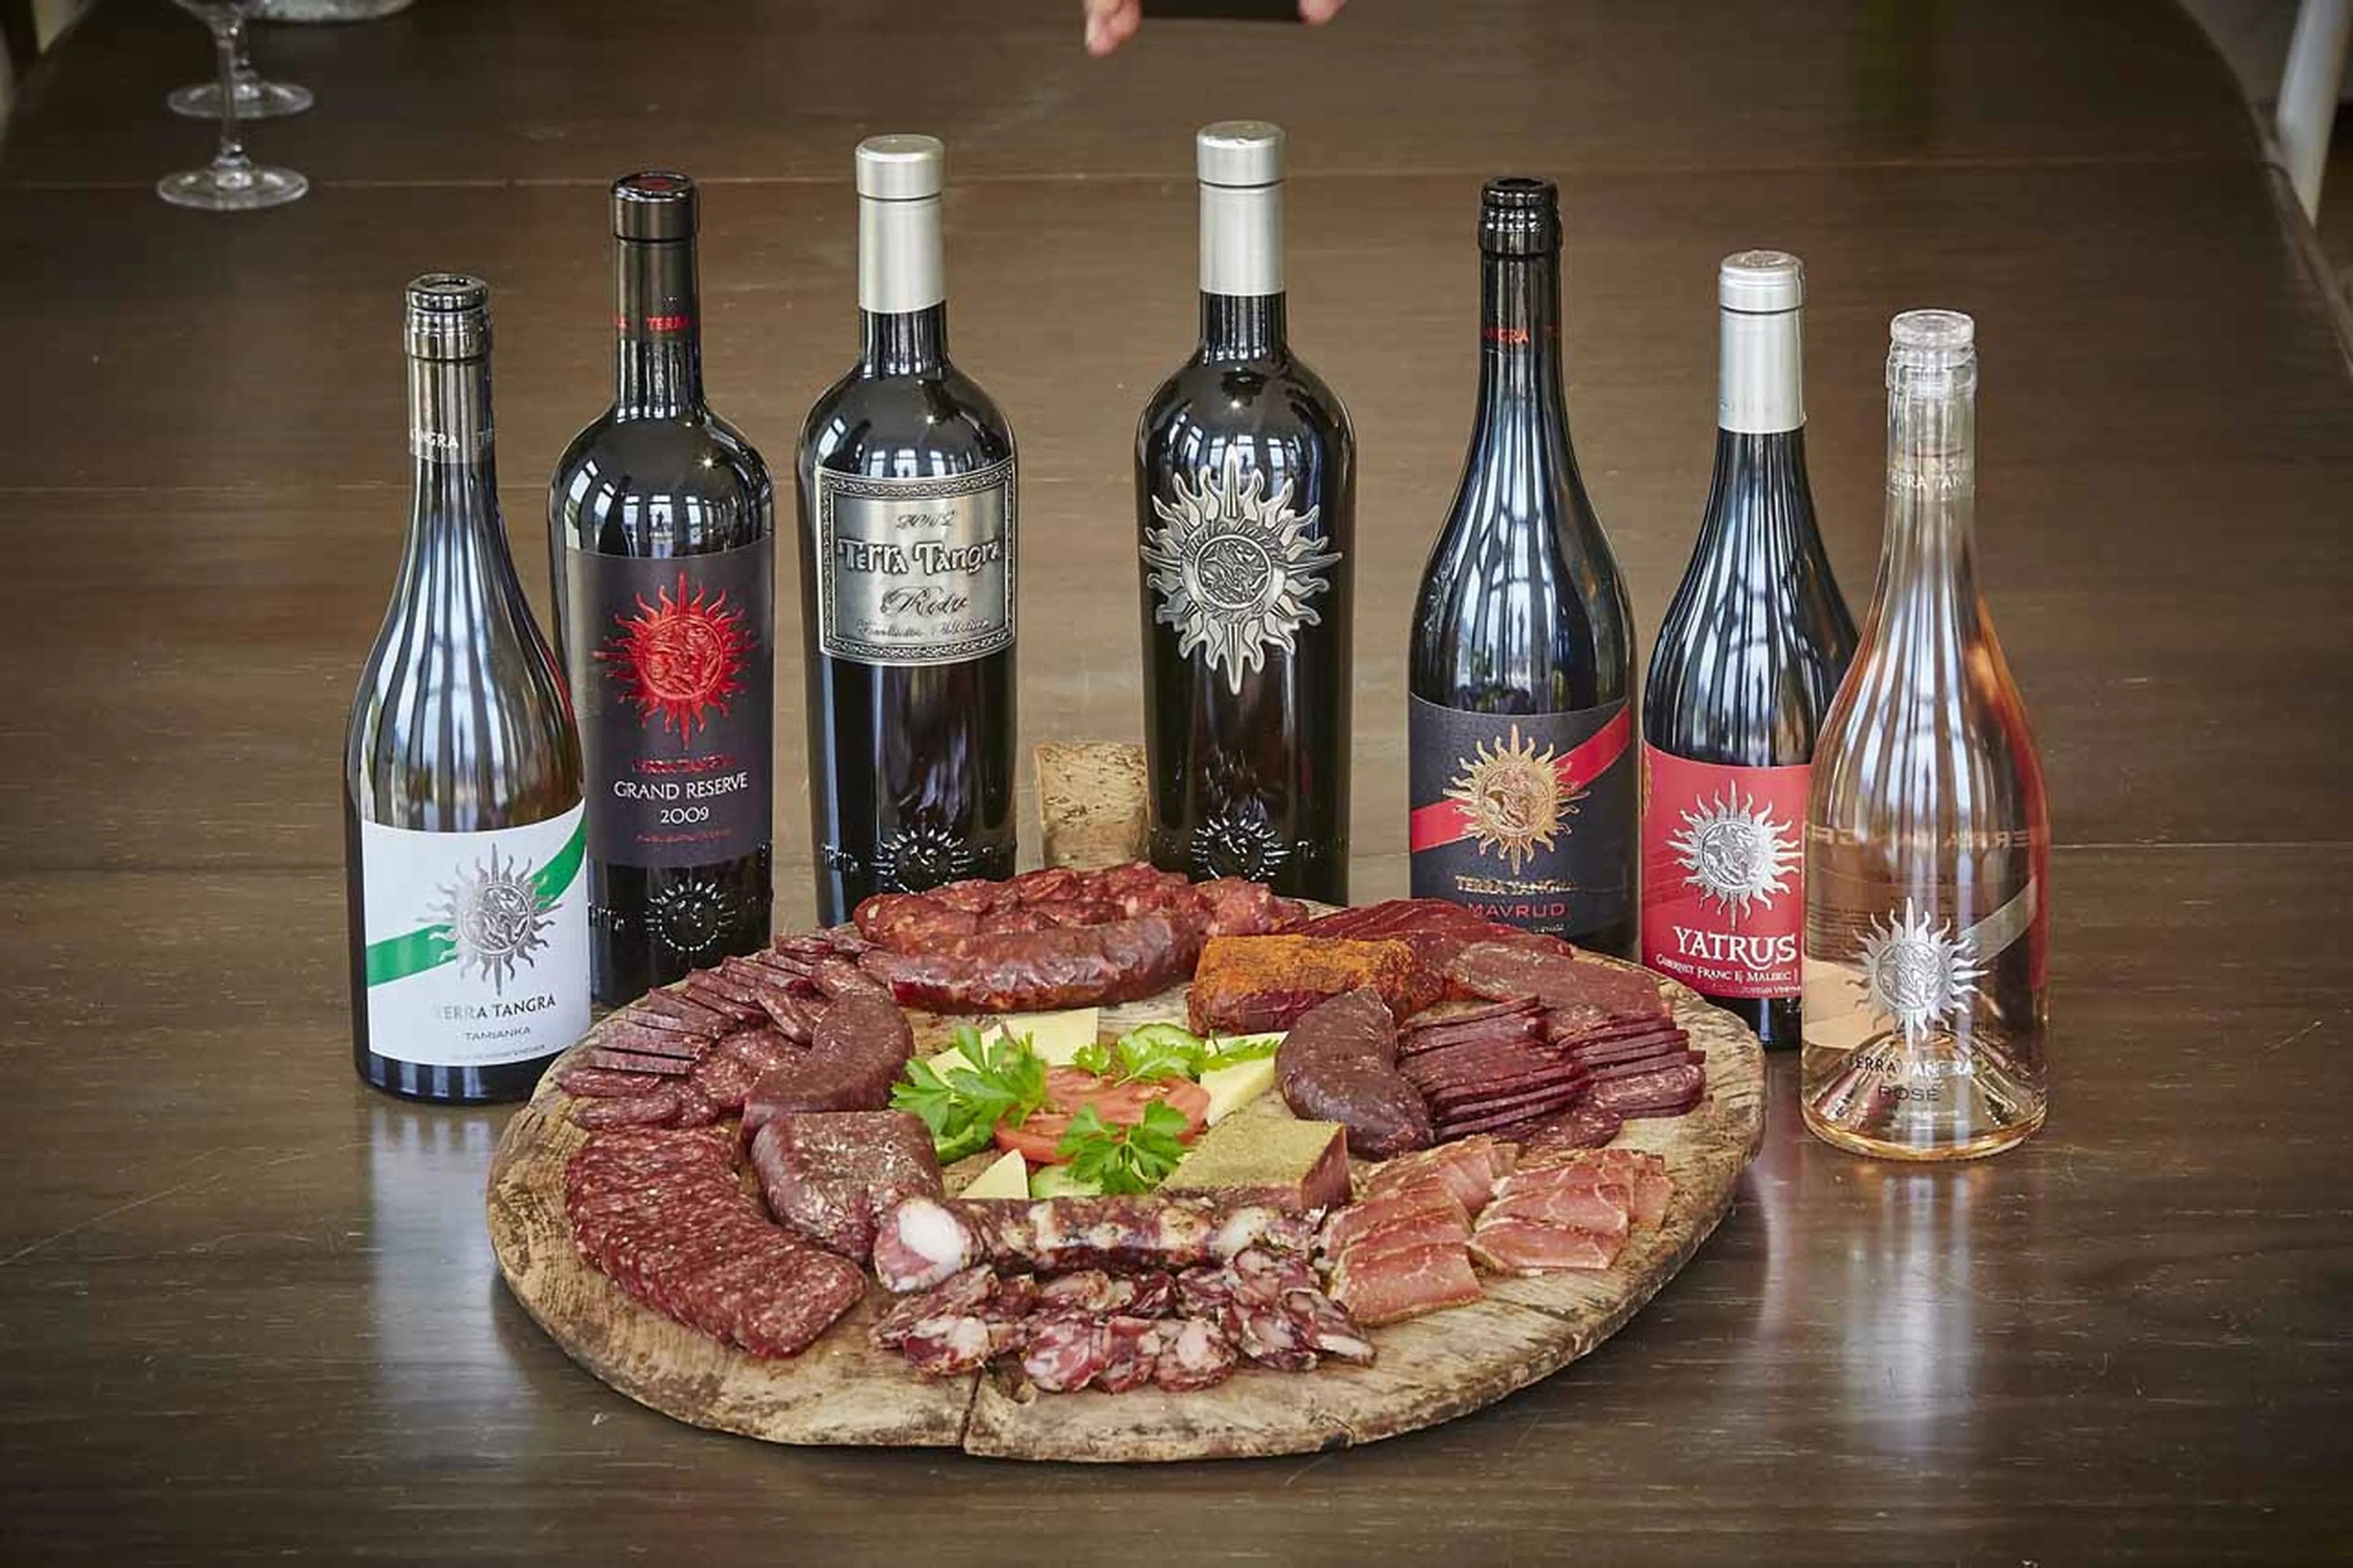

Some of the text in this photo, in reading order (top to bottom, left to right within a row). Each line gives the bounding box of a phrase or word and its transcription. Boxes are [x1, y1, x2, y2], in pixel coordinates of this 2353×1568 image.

[613, 771, 748, 800] GRAND RESERVE
[659, 806, 710, 824] 2009
[1468, 903, 1566, 918] MAVRUD
[1672, 925, 1797, 971] YATRUS
[1697, 966, 1732, 981] FRANC
[491, 992, 557, 1018] TANGRA
[464, 1026, 531, 1041] TAMIANKA
